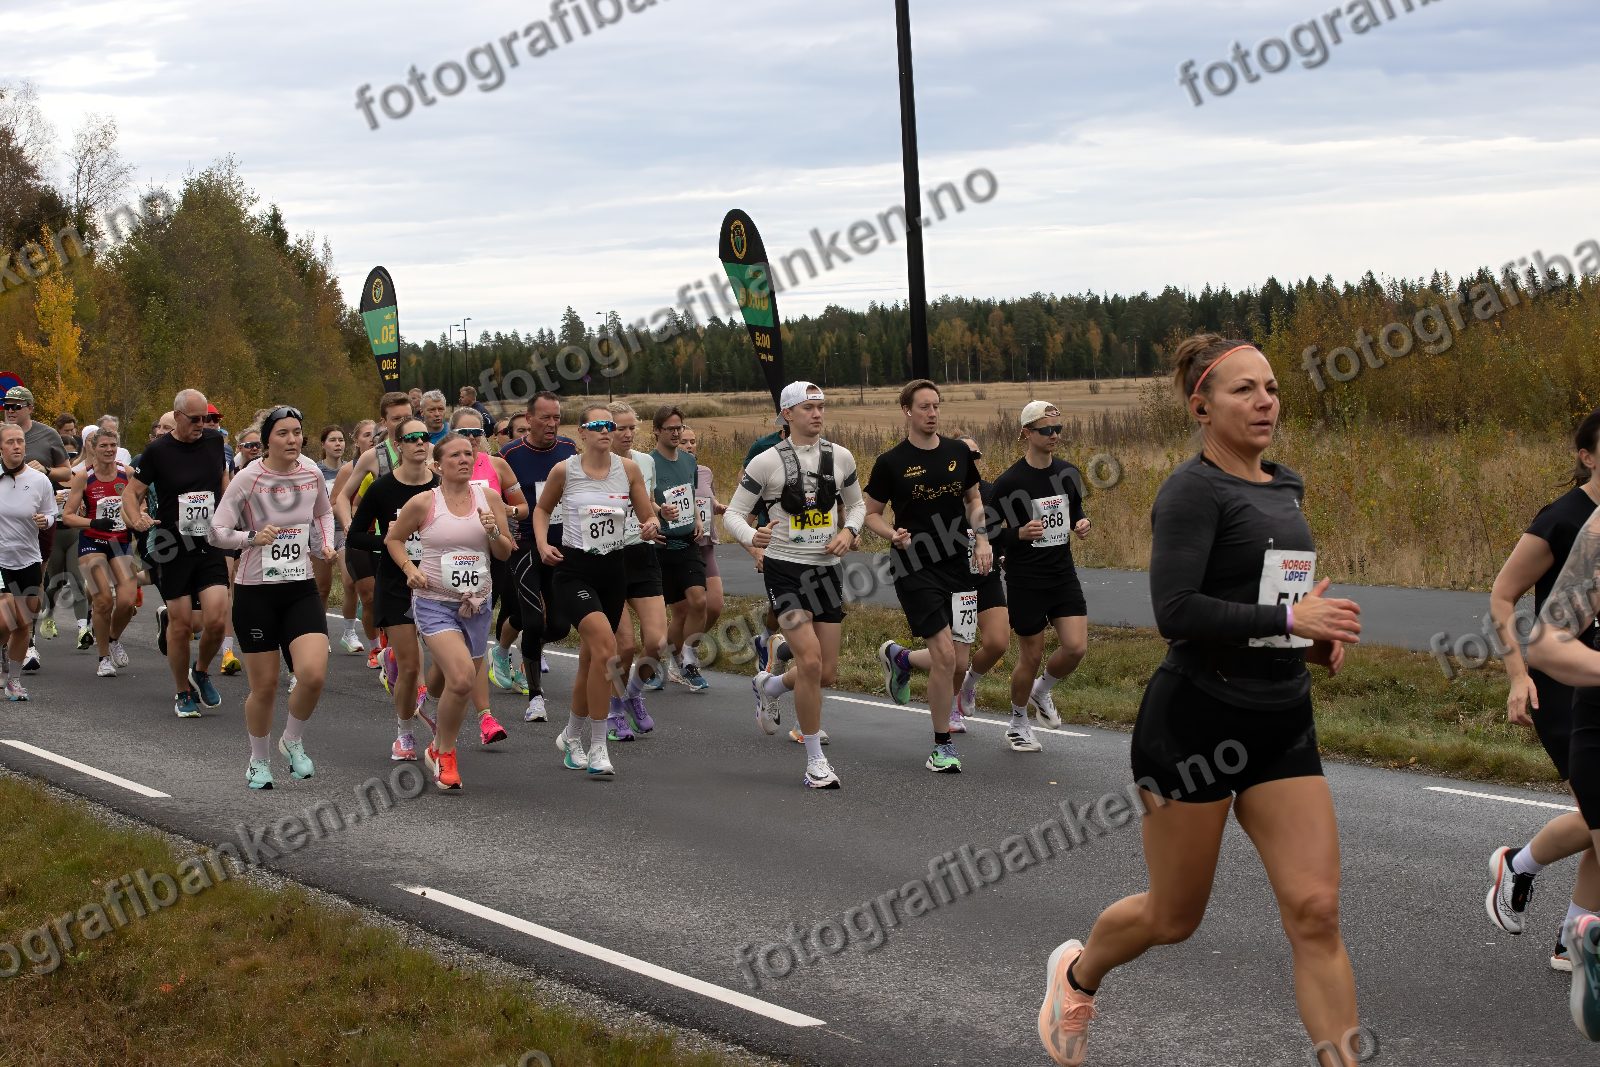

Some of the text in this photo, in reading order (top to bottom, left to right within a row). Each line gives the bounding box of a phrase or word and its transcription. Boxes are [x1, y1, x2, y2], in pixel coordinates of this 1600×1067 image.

[186, 506, 209, 521] 370
[589, 518, 615, 539] 873
[271, 543, 300, 561] 649
[1280, 559, 1312, 571] NORGES
[451, 570, 479, 588] 546
[1284, 571, 1308, 582] LØPET
